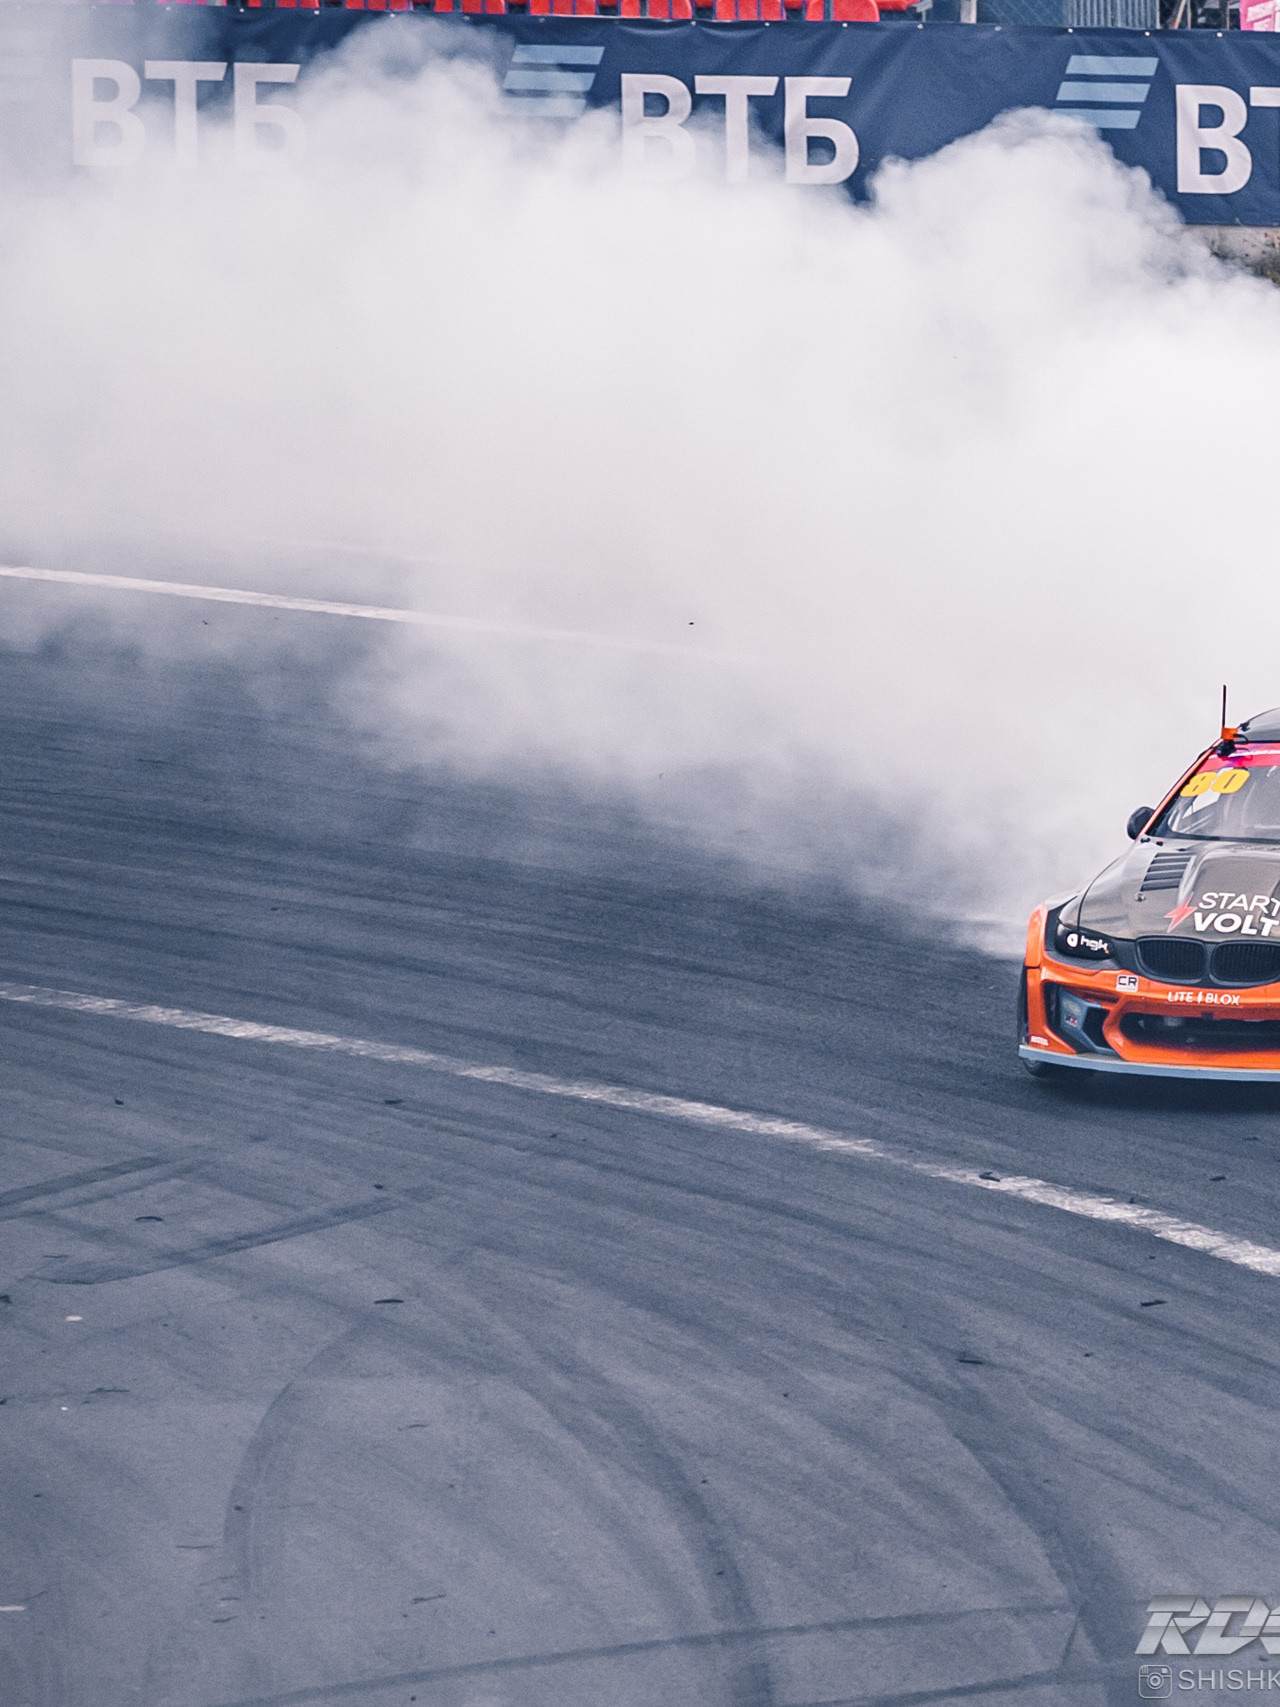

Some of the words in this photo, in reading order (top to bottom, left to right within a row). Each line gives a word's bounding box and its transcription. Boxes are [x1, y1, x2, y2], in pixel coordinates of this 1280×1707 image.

[70, 58, 308, 168] ВТБ
[620, 73, 860, 186] ВТБ
[1180, 768, 1250, 797] 80
[1194, 912, 1280, 937] VOLT
[1080, 935, 1109, 951] hgk
[1118, 976, 1138, 988] CR
[1166, 990, 1194, 1003] LITE
[1204, 992, 1241, 1006] BLOX
